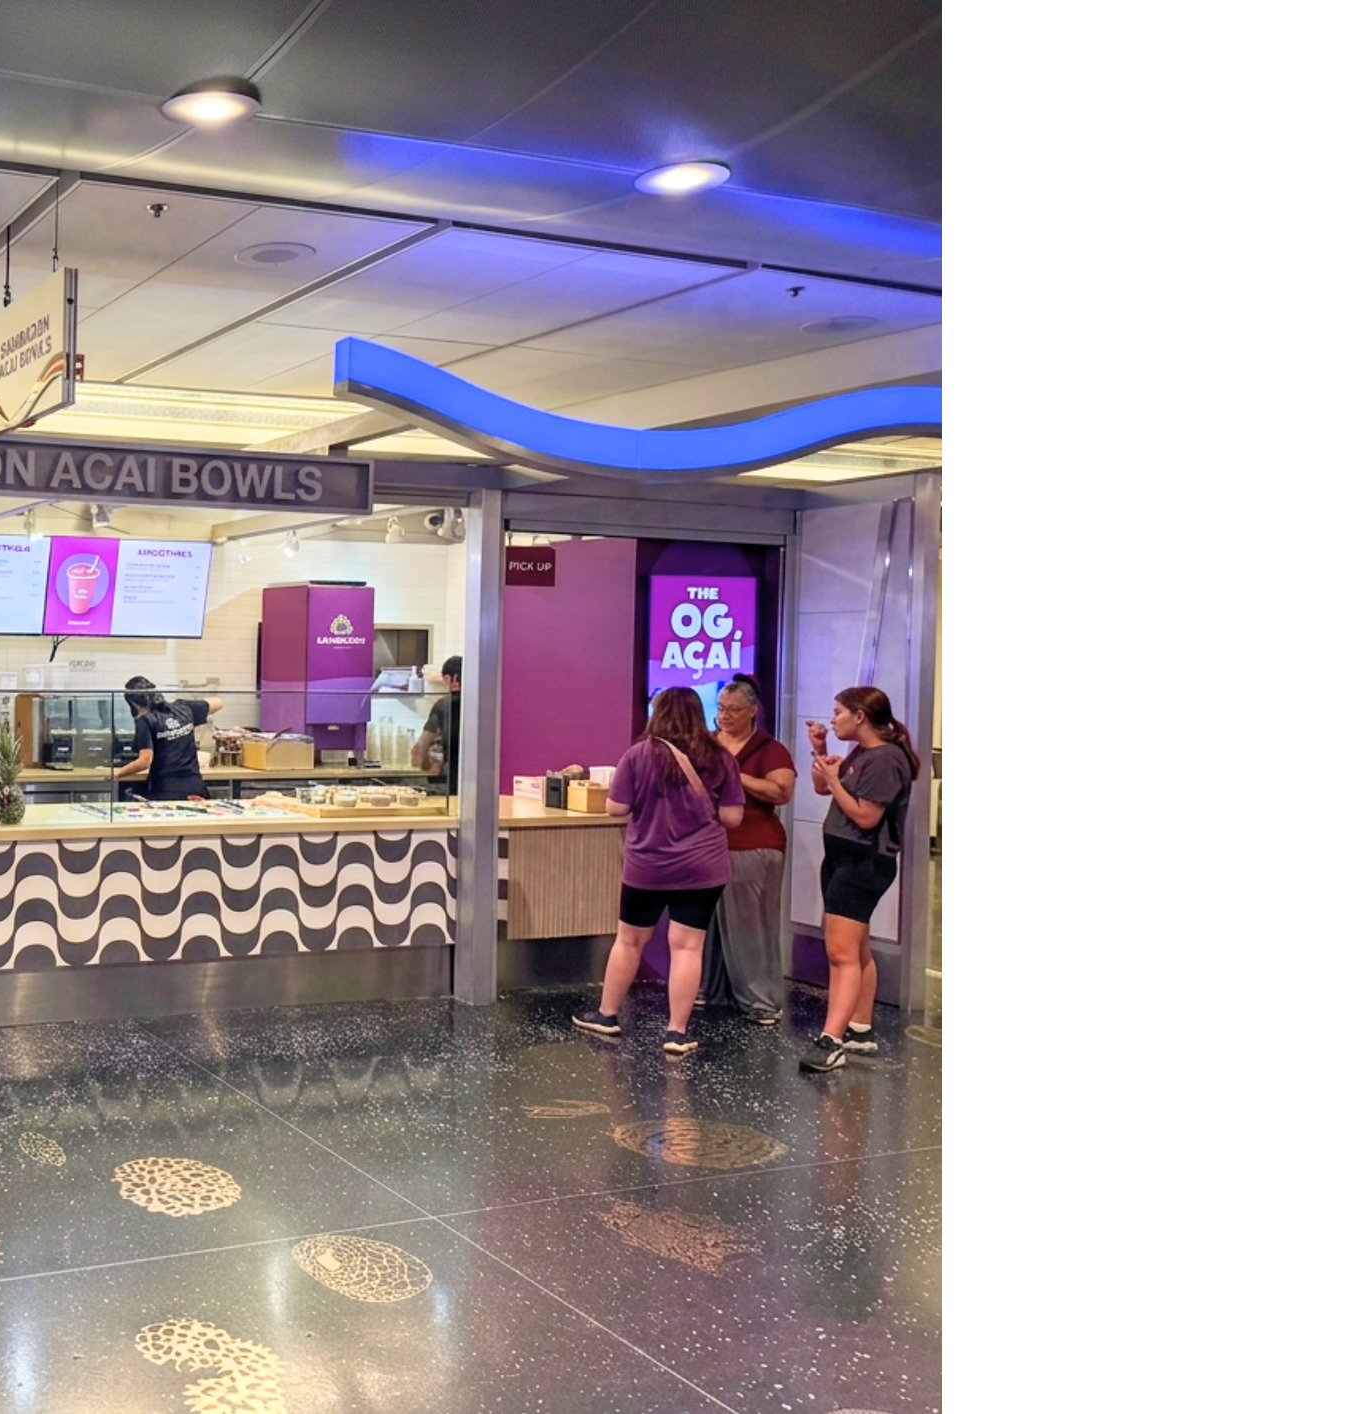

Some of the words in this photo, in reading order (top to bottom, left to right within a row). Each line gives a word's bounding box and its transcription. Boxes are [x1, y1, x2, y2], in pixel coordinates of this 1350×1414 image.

[50, 451, 156, 493] ACAI
[170, 456, 324, 502] BOWLS
[508, 560, 534, 571] PICK
[536, 561, 553, 571] UP
[686, 586, 720, 601] THE
[670, 602, 734, 640] OG
